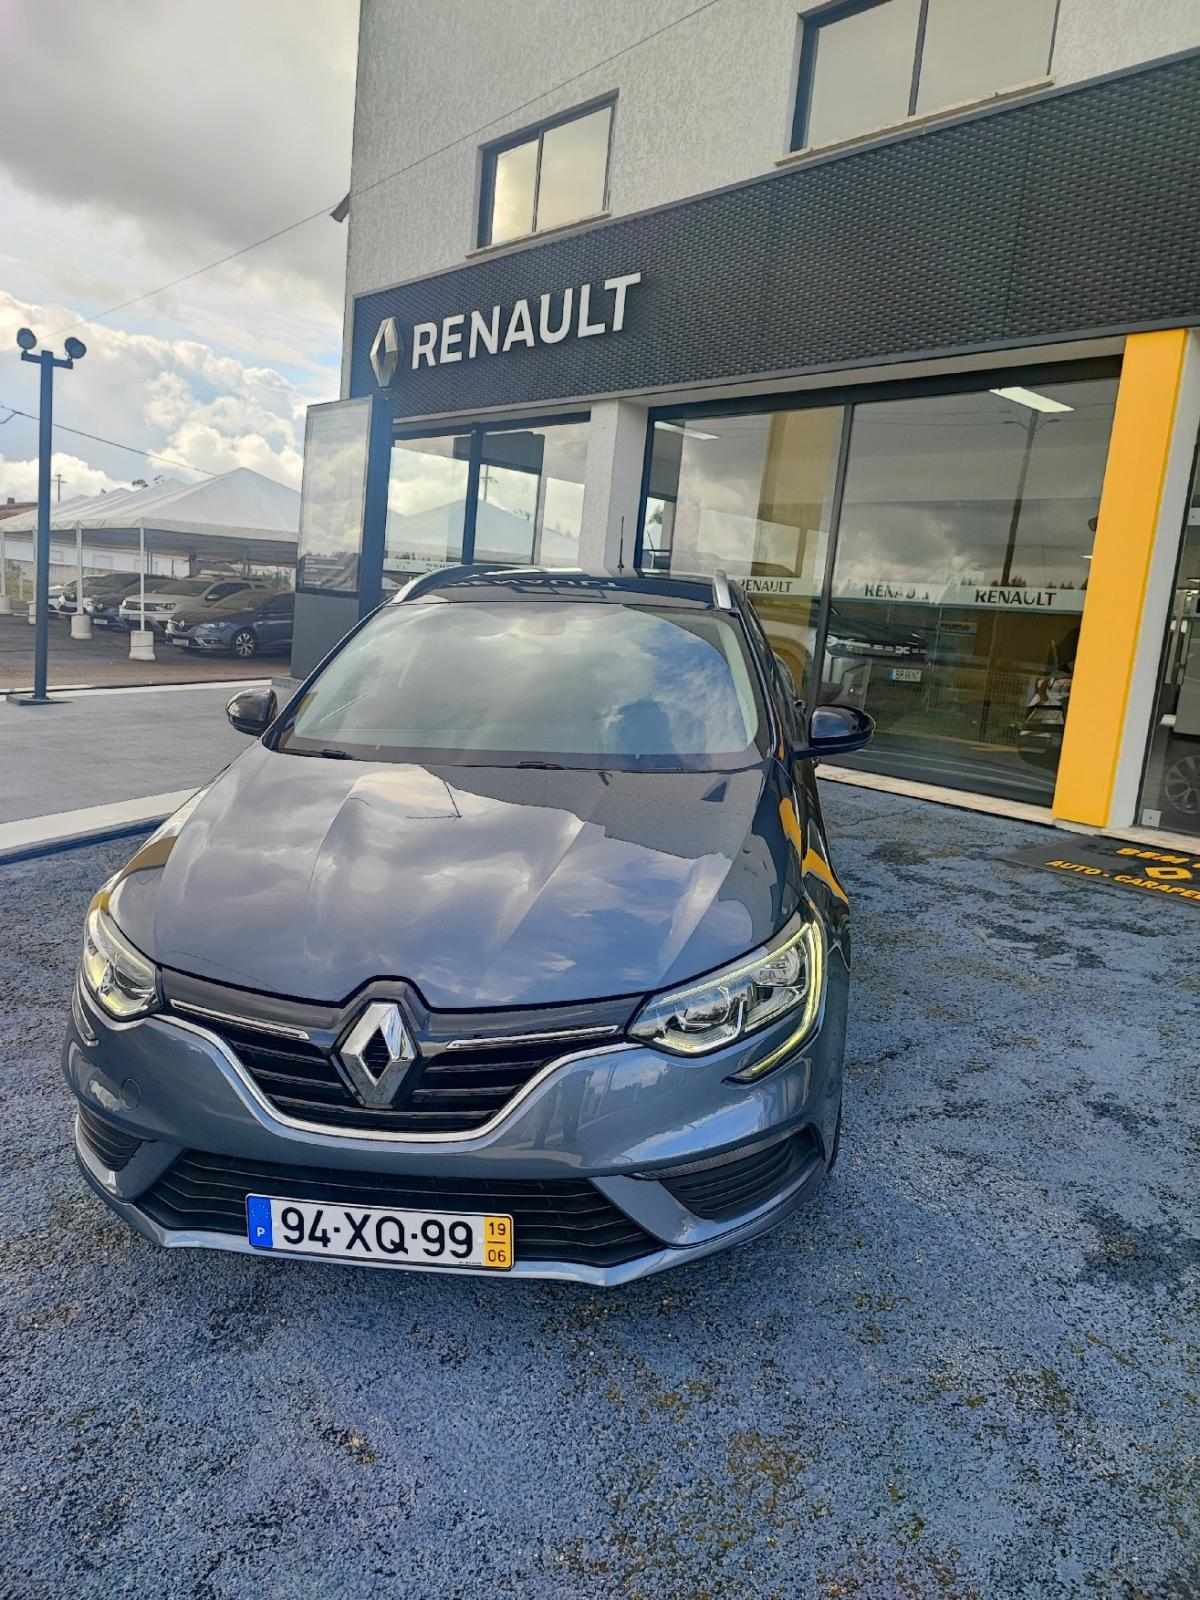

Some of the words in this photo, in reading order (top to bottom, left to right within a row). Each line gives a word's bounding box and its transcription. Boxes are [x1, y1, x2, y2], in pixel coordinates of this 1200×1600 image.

[411, 272, 642, 370] RENAULT
[975, 589, 1057, 606] RENAULT
[1044, 860, 1102, 875] AUTO
[257, 1227, 265, 1238] P
[489, 1222, 506, 1236] 19
[488, 1249, 506, 1262] 06
